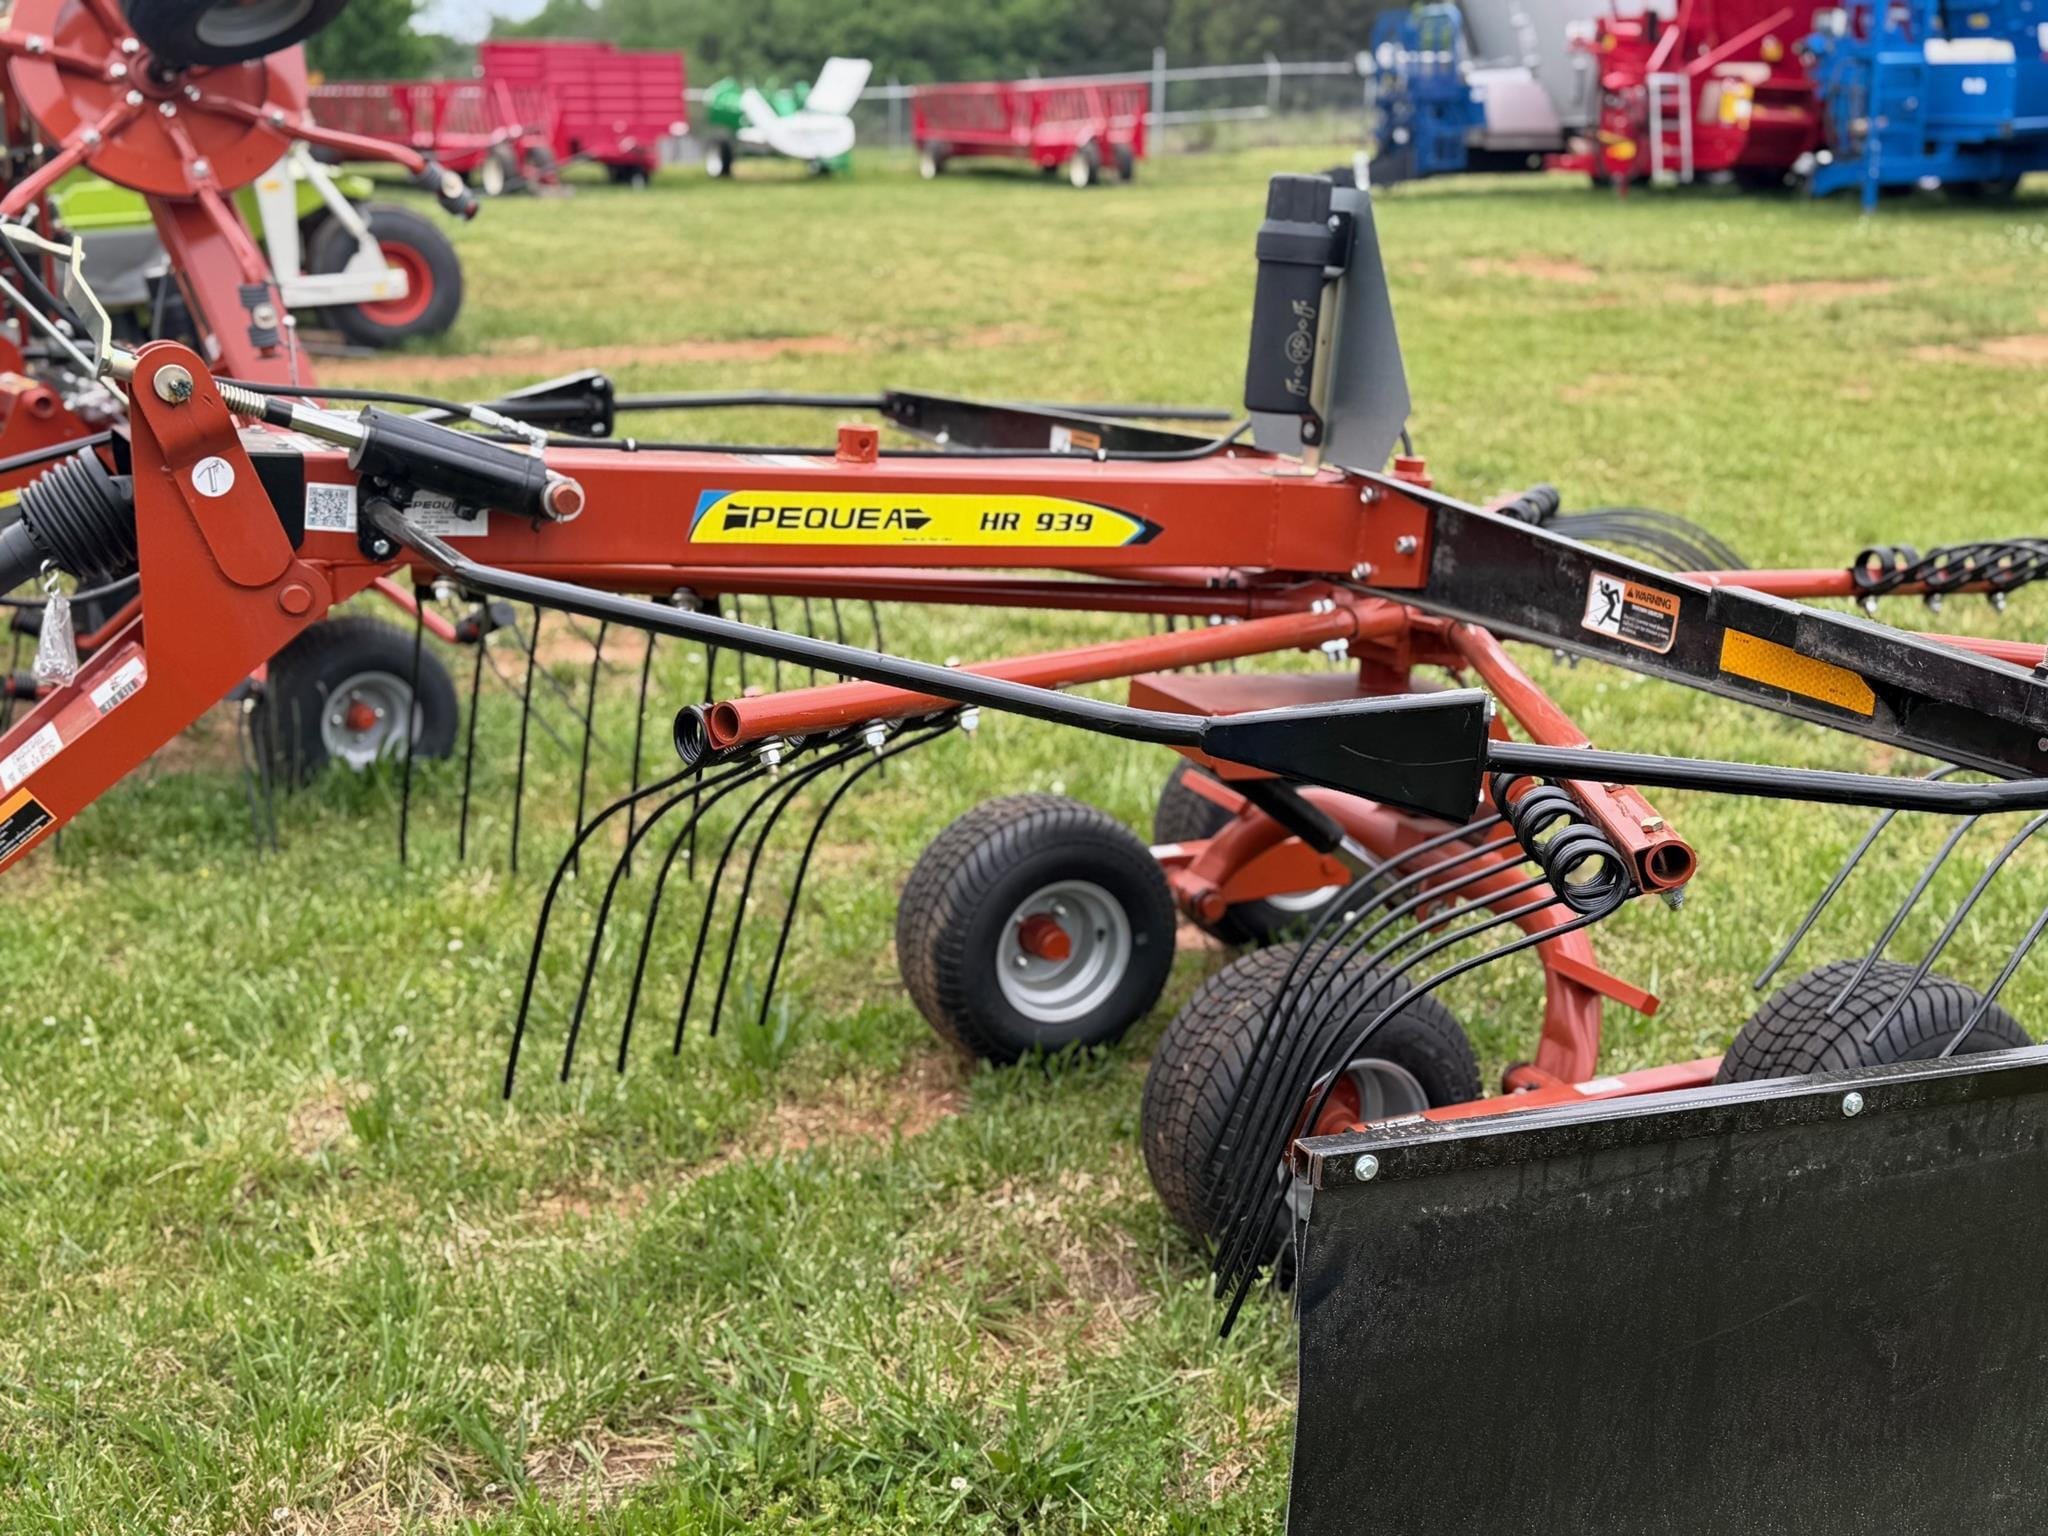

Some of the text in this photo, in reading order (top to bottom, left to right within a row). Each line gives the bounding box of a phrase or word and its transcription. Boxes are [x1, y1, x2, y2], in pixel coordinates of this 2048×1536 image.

[749, 506, 1094, 532] PEQUEA HR 939
[1635, 589, 1672, 610] WARNING
